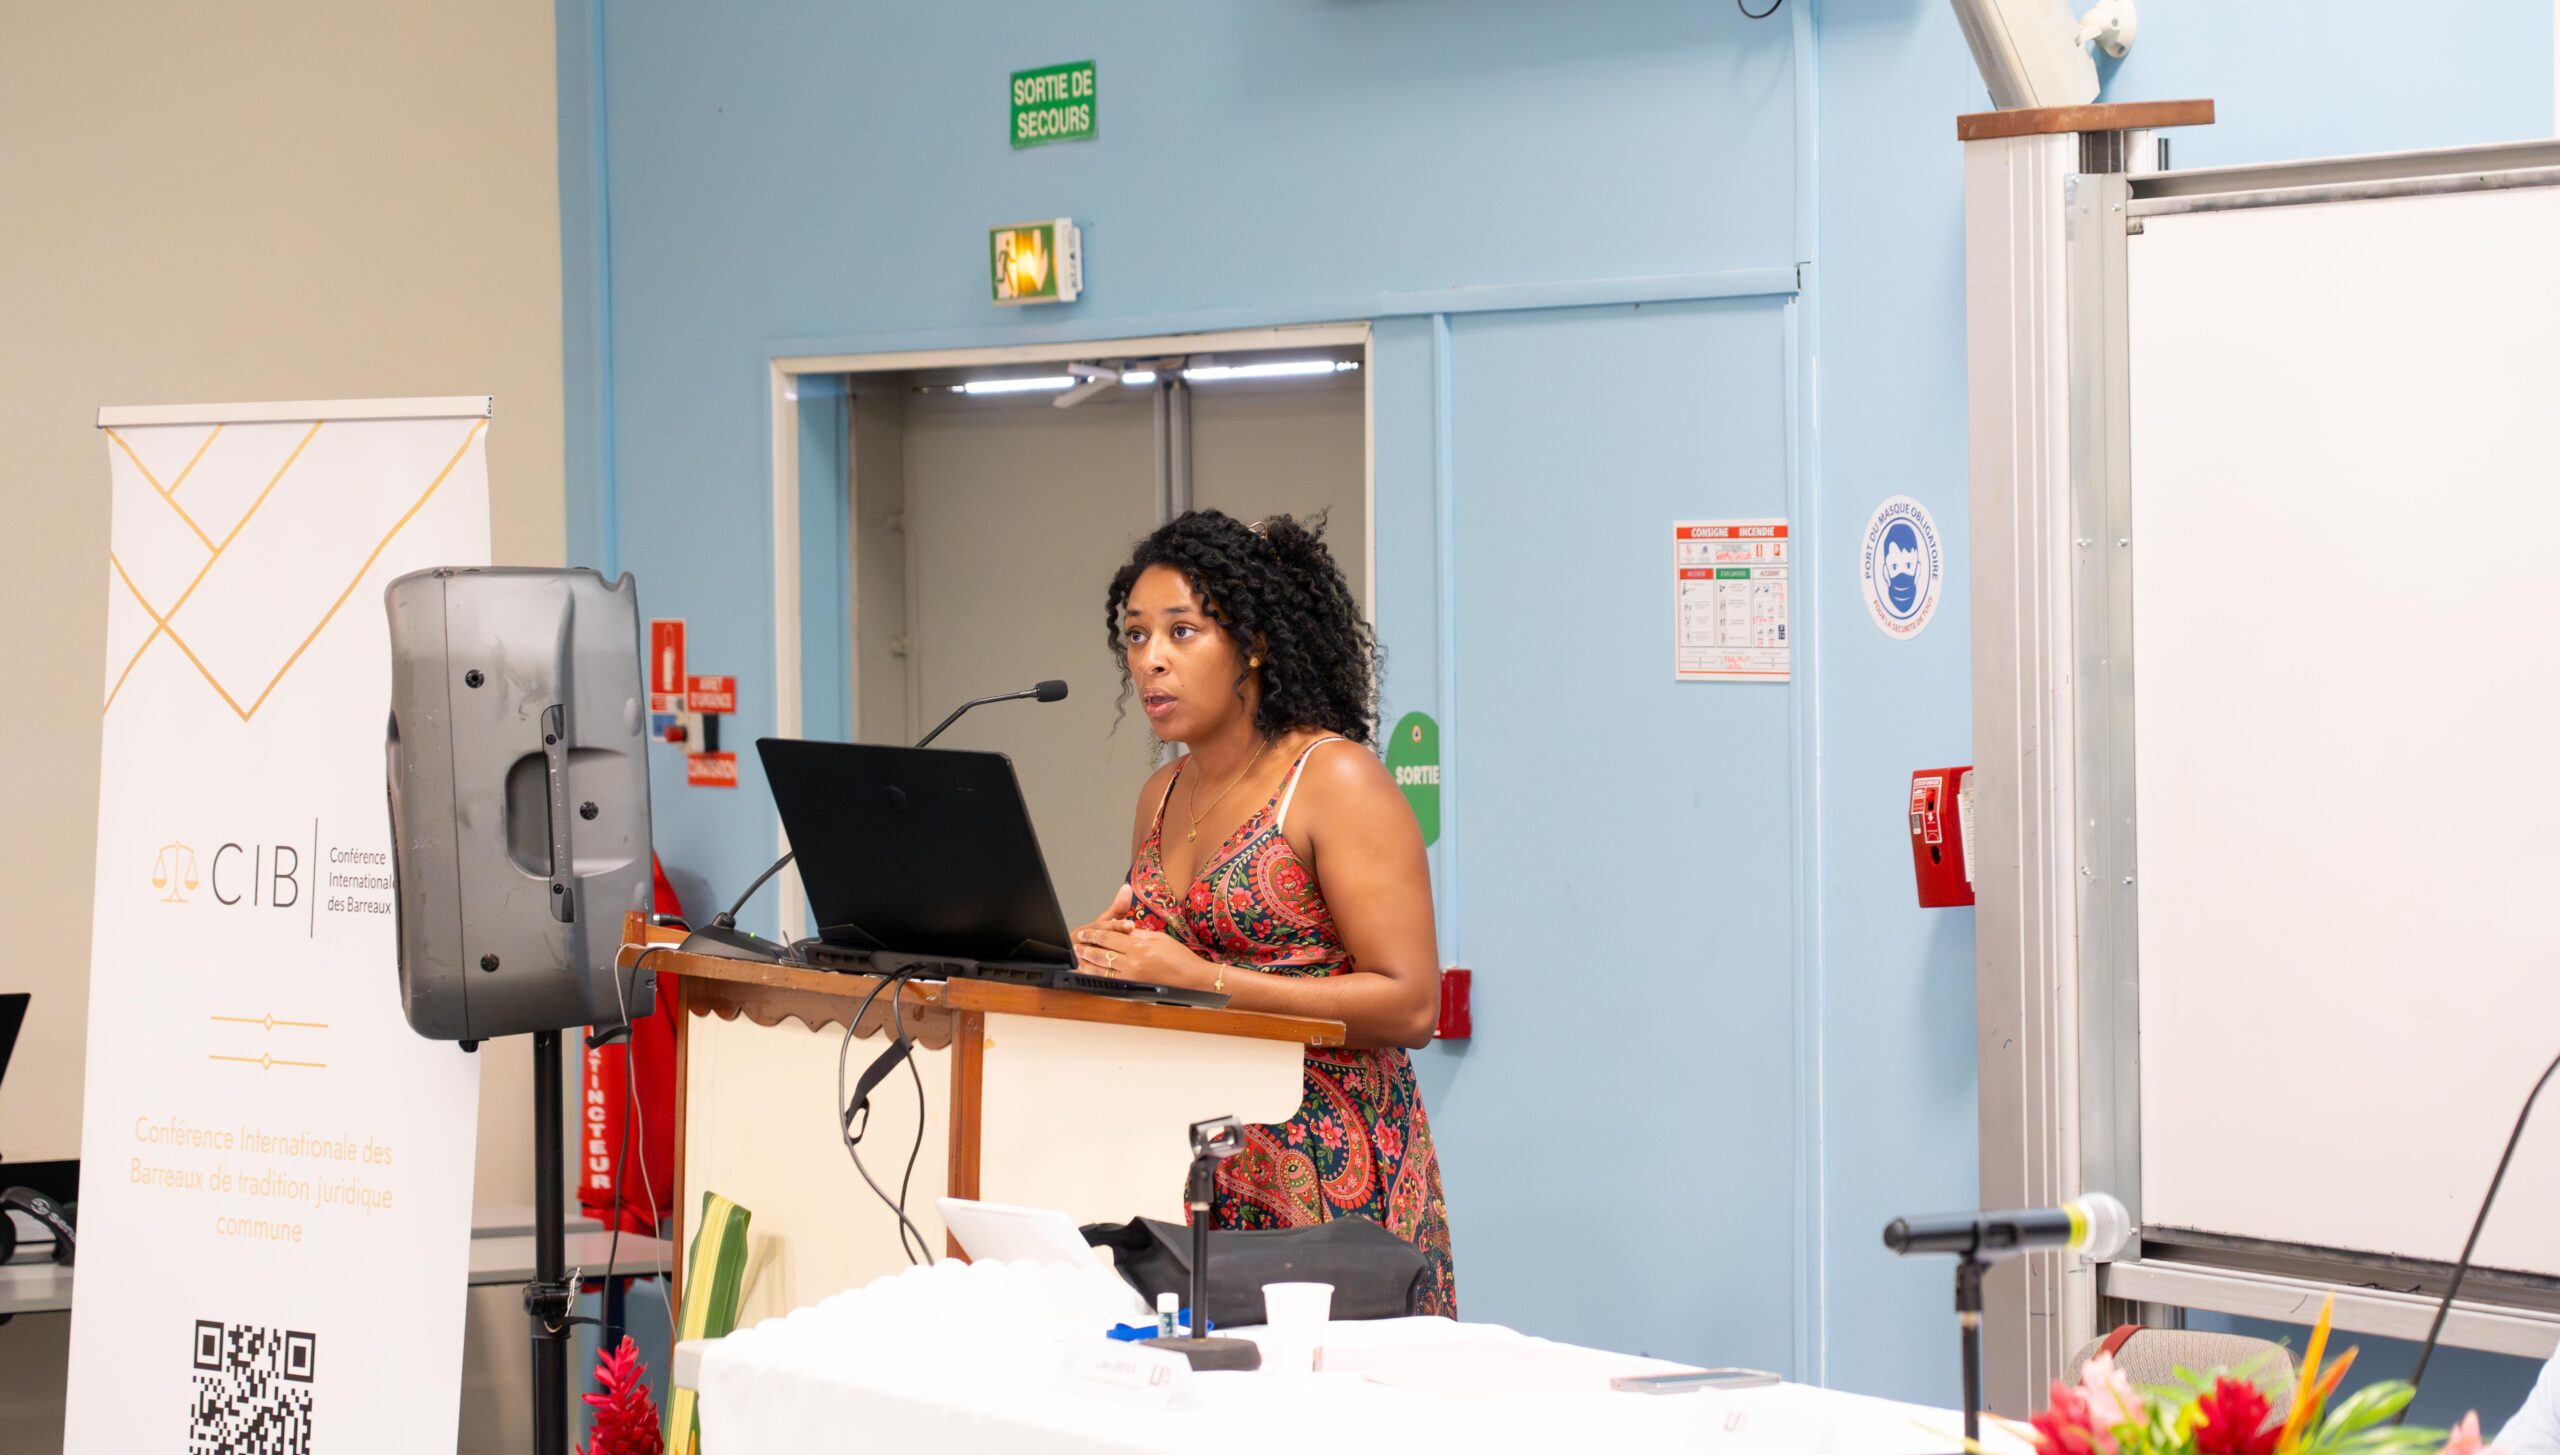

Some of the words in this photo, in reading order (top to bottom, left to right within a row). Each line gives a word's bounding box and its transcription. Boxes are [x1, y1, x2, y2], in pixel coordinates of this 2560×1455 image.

[1014, 73, 1068, 106] SORTIE
[1071, 69, 1093, 97] DE
[1017, 104, 1090, 139] SECOURS
[1878, 503, 1910, 525] MASQUE
[1691, 527, 1729, 537] CONSIGNE
[1739, 526, 1775, 537] INCENDIE
[1869, 524, 1879, 542] DU
[1910, 507, 1938, 580] OBLIGATOIRE
[1865, 544, 1874, 579] PORT
[1395, 765, 1439, 785] SORTIE
[329, 847, 386, 865] Conférence
[212, 842, 299, 907] CIB
[327, 896, 345, 912] des
[347, 897, 391, 915] Barreaux
[135, 1115, 234, 1150] Conférence
[240, 1125, 357, 1162] Internationale
[362, 1135, 393, 1165] des
[130, 1157, 203, 1189] Barreaux
[209, 1163, 232, 1193] de
[238, 1167, 309, 1200] tradition
[315, 1176, 393, 1213] juridique
[216, 1215, 303, 1242] commune
